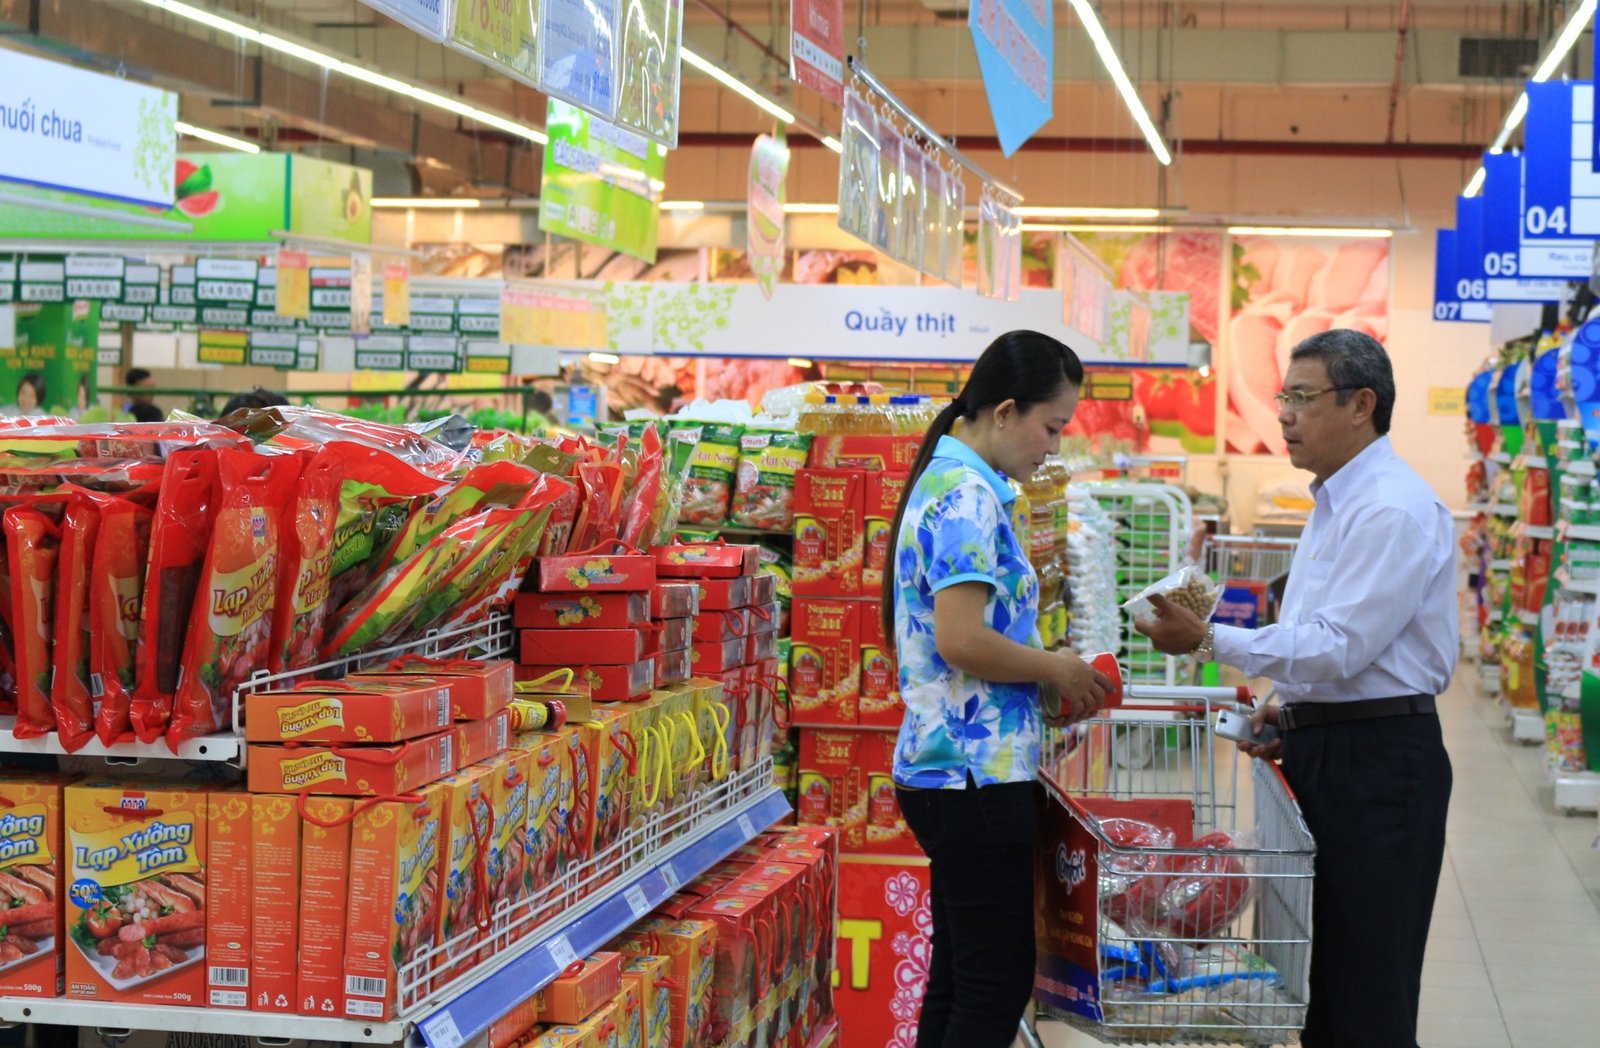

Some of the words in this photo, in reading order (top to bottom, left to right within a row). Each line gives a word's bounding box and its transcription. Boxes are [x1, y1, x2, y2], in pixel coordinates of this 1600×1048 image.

[41, 109, 82, 144] chua
[1526, 206, 1568, 234] 04
[1484, 253, 1518, 276] 05
[1457, 280, 1485, 299] 06
[1435, 303, 1459, 320] 07
[845, 307, 907, 337] Quầy
[916, 312, 955, 337] thịt
[810, 475, 848, 486] Neptune
[882, 477, 905, 487] Nept
[213, 588, 249, 617] Lạp
[808, 604, 845, 616] Neptune
[318, 706, 341, 720] Lạp
[320, 760, 344, 773] Lạp
[0, 838, 38, 860] ôm
[76, 846, 119, 871] Lạp
[119, 820, 193, 860] Xưởng
[137, 846, 187, 874] Tôm
[70, 883, 99, 899] 50%
[83, 896, 100, 905] Tôm
[23, 984, 42, 992] 500g
[173, 993, 191, 1002] 500g
